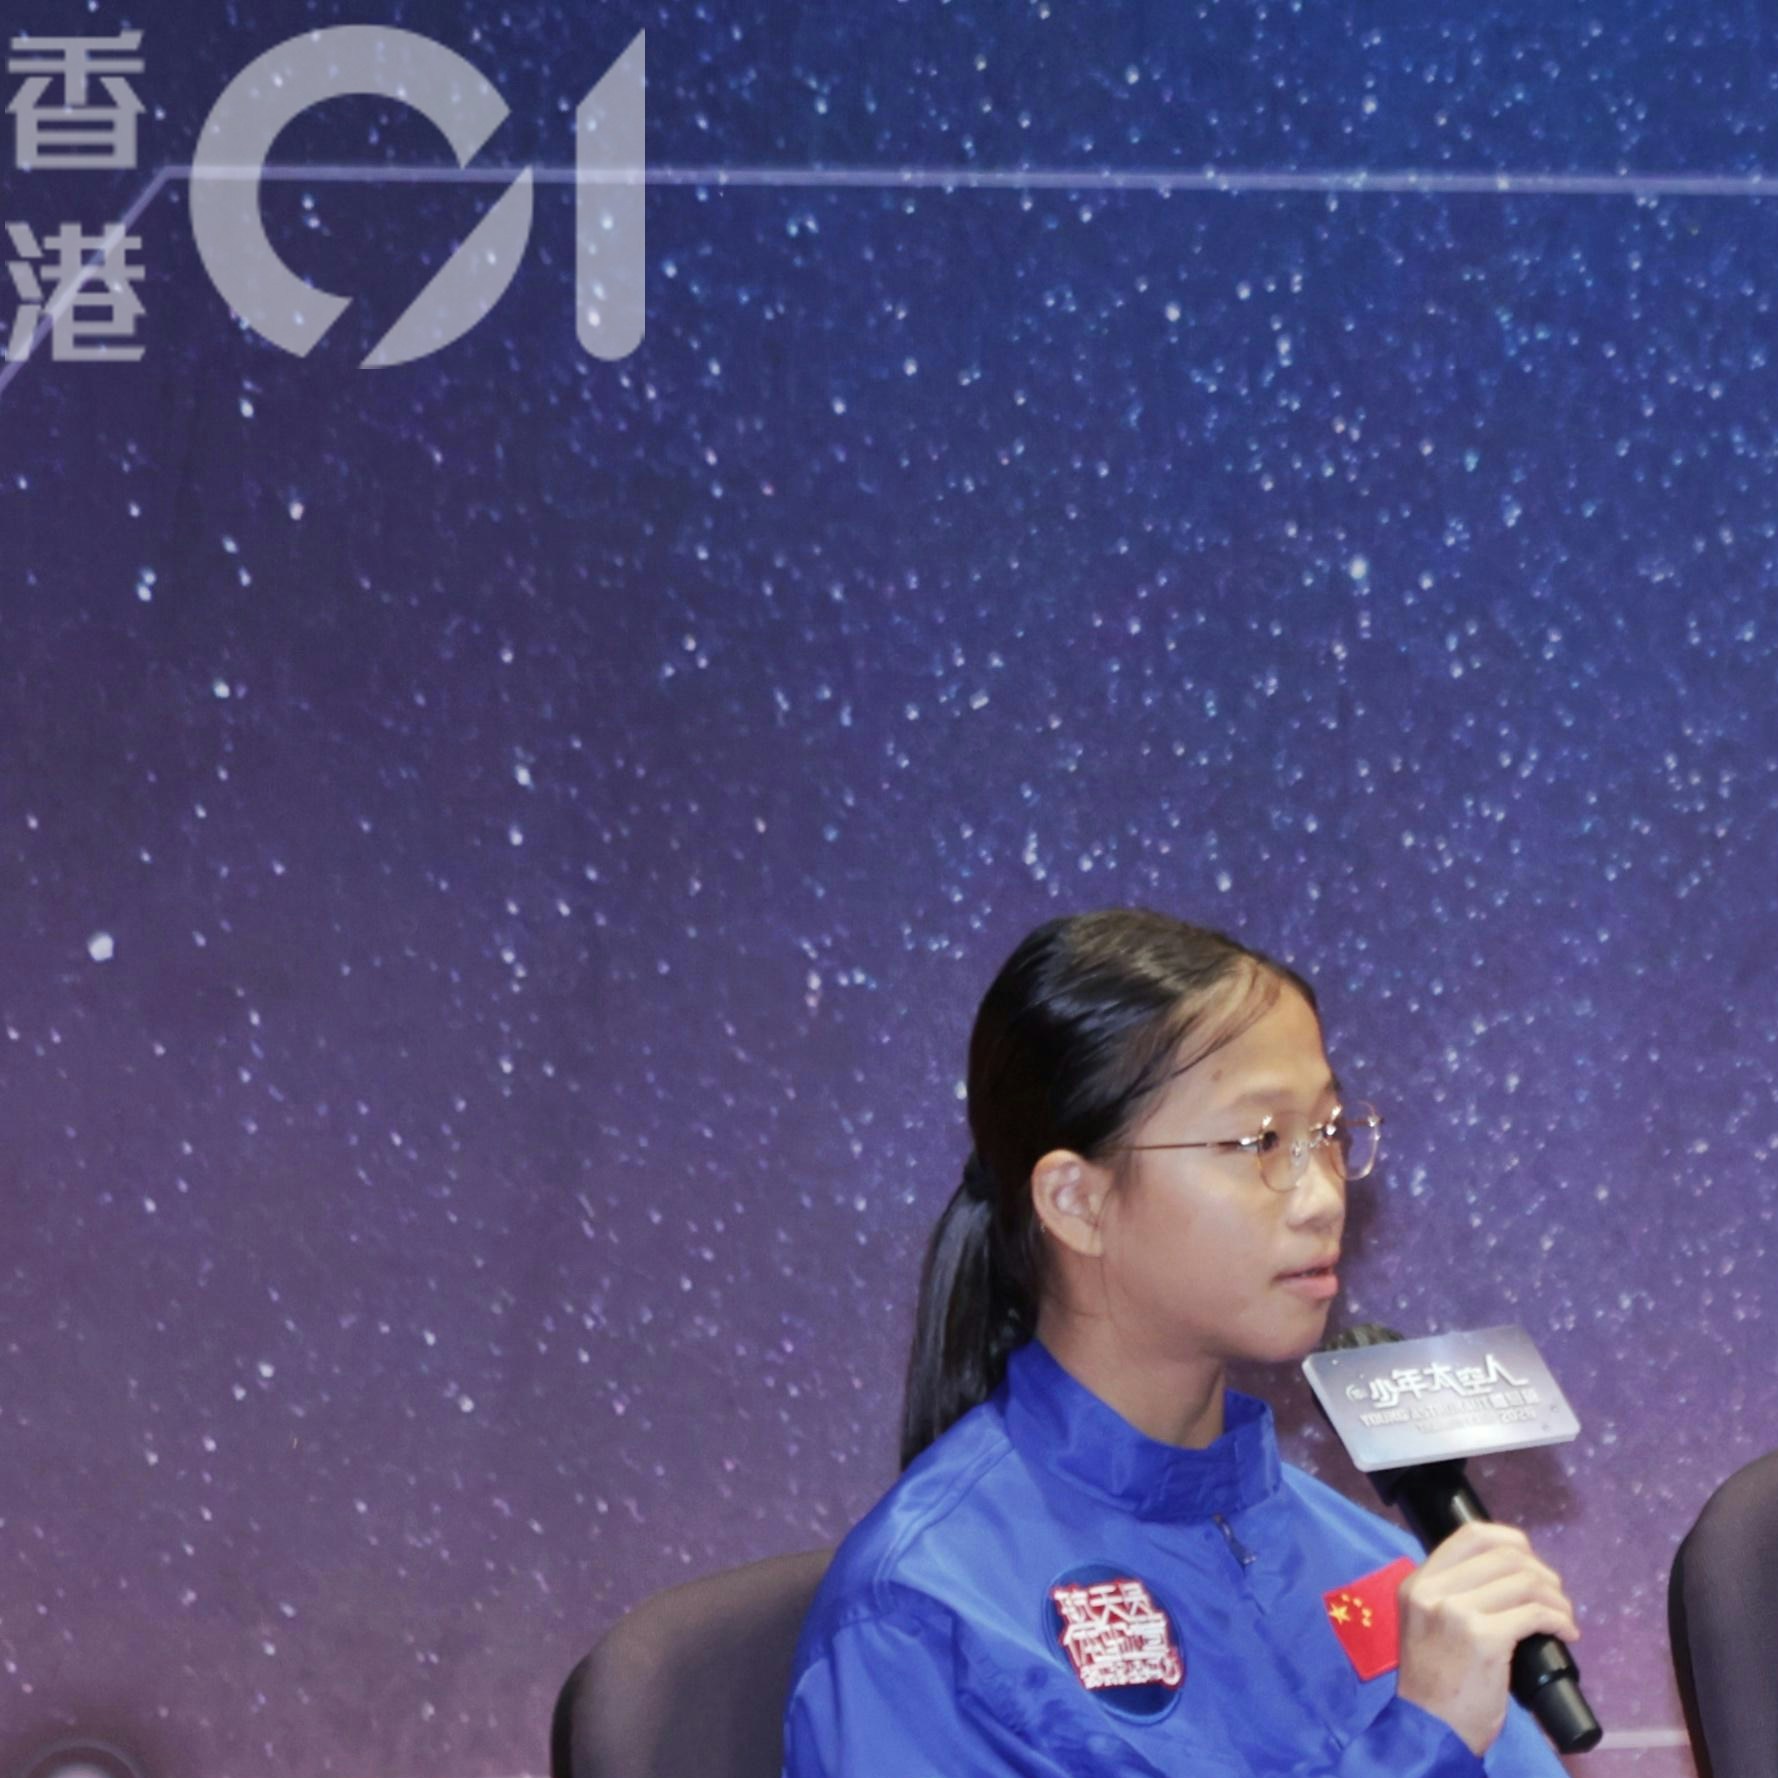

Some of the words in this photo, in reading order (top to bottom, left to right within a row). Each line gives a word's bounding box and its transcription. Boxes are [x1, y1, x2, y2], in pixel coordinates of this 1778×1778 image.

[1368, 1353, 1529, 1409] 少年太空人
